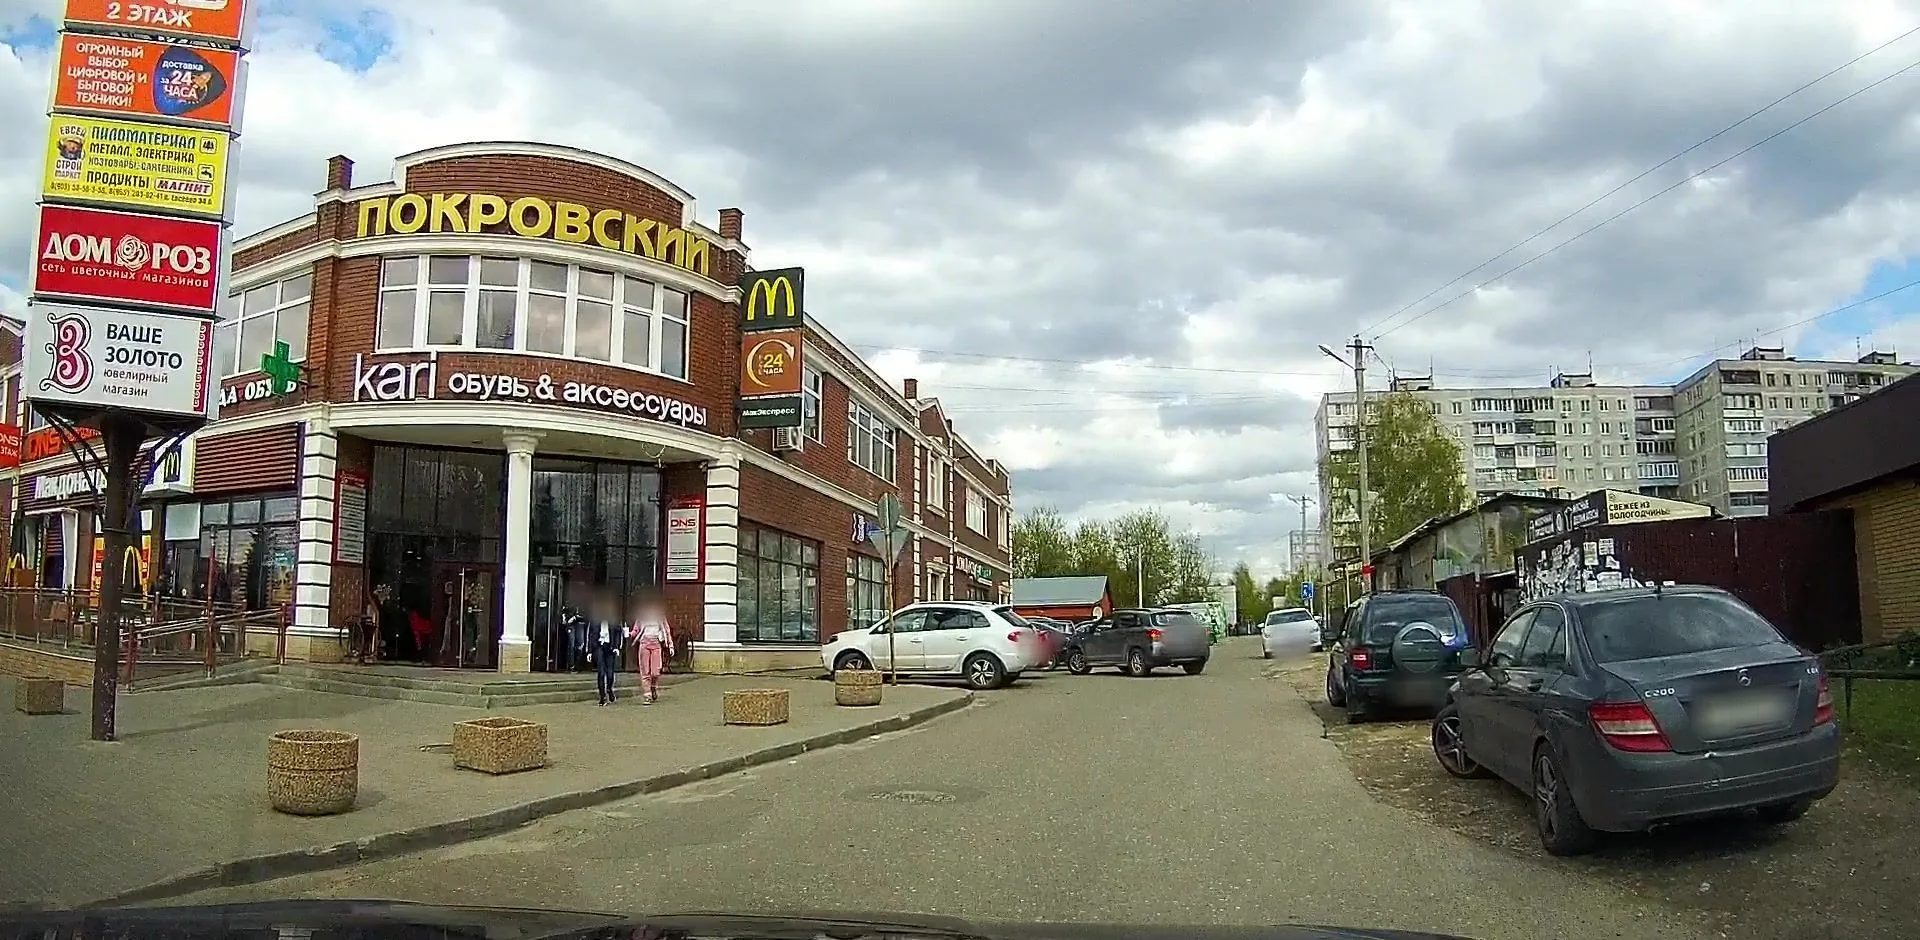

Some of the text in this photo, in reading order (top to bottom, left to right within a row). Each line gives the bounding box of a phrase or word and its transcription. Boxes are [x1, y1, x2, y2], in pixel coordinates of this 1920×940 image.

[107, 3, 120, 19] 2
[127, 4, 192, 28] ЭТАЖ
[76, 43, 144, 58] ОГРОМНЫЙ
[88, 56, 128, 69] ВЫБОР
[162, 61, 203, 71] доставка
[68, 67, 147, 83] ЦИФРОВОЙ И
[171, 70, 192, 85] 24
[78, 80, 134, 95] БЫТОВОЙ
[165, 85, 197, 98] ЧАСА
[76, 92, 132, 107] ТЕХНИКИ!
[91, 126, 196, 149] ПИЛОМАТЕРИАЛ
[136, 146, 195, 163] ЭЛЕКТРИКА
[87, 171, 149, 188] ПРОДУКТЫ
[157, 179, 210, 193] МАГНИТ
[42, 232, 211, 274] ДОМ РОЗ
[41, 264, 209, 288] сеть цветочных магазинов
[106, 323, 163, 345] ВАШЕ
[104, 346, 182, 369] ЗОЛОТО
[763, 353, 784, 368] 24
[103, 368, 169, 384] ювелирный
[354, 349, 438, 401] kari
[763, 366, 784, 375] ЧАСА
[102, 385, 148, 397] магазин
[449, 373, 707, 428] обувь & аксессуары
[29, 431, 62, 460] DNS
[1608, 502, 1638, 511] СВЕЖЕЕ
[670, 518, 696, 527] DNS
